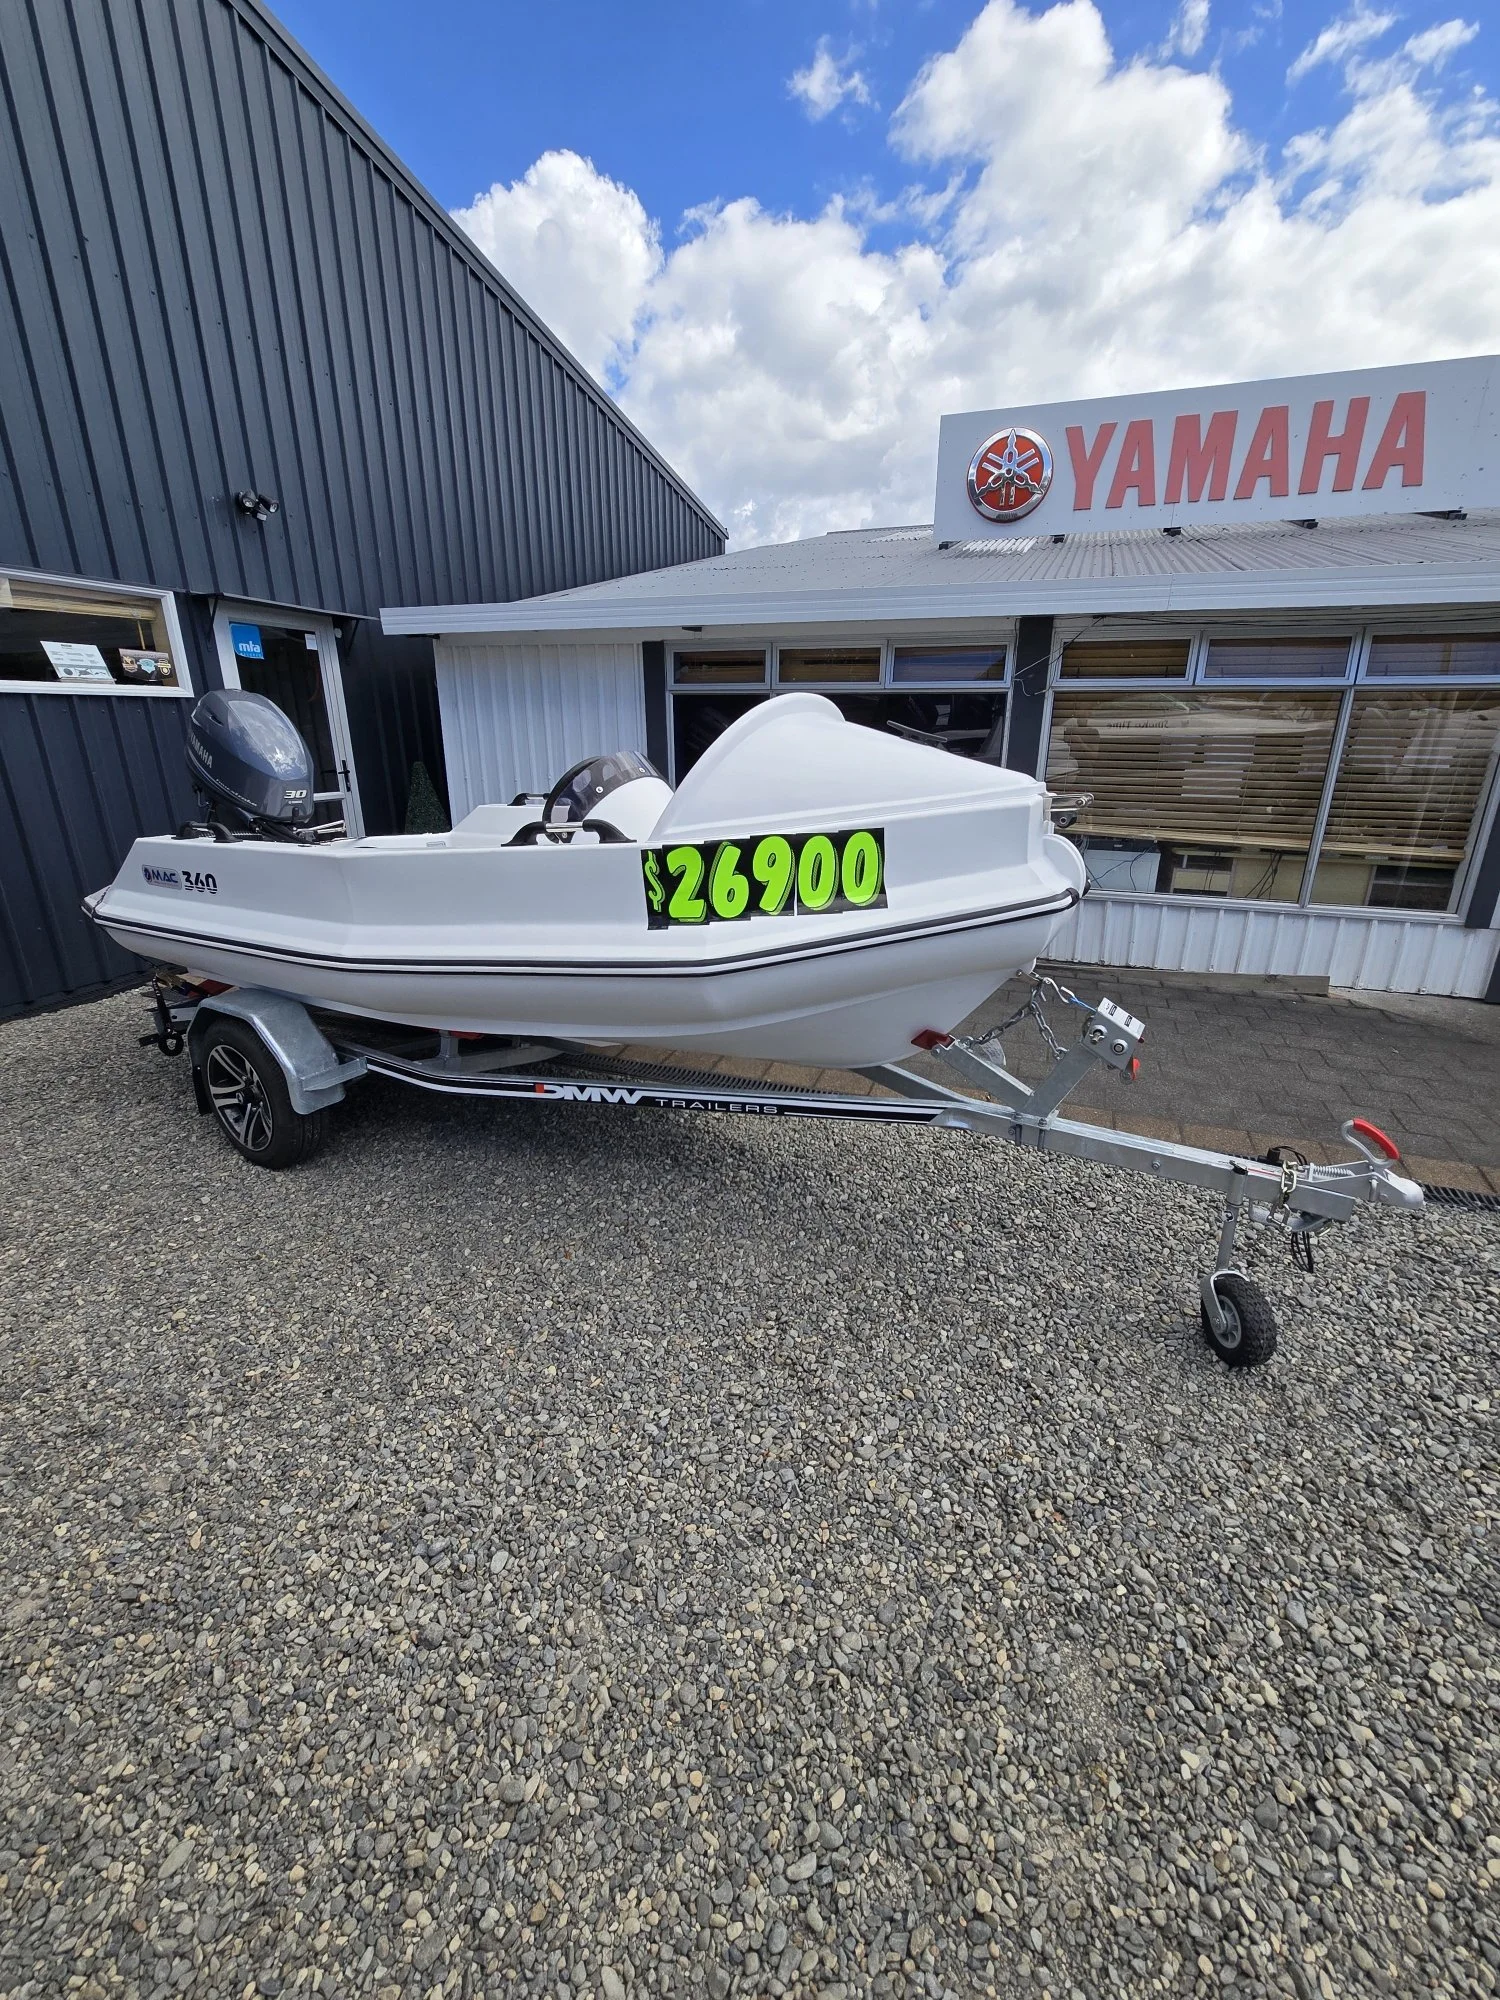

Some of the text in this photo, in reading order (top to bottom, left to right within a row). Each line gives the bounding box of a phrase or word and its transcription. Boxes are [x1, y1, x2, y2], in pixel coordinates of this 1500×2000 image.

[1065, 391, 1426, 511] YAMAHA
[283, 789, 307, 799] 30
[151, 868, 218, 895] MAC 360
[644, 831, 882, 922] $26900
[535, 1082, 778, 1115] DMW TRAILERS
